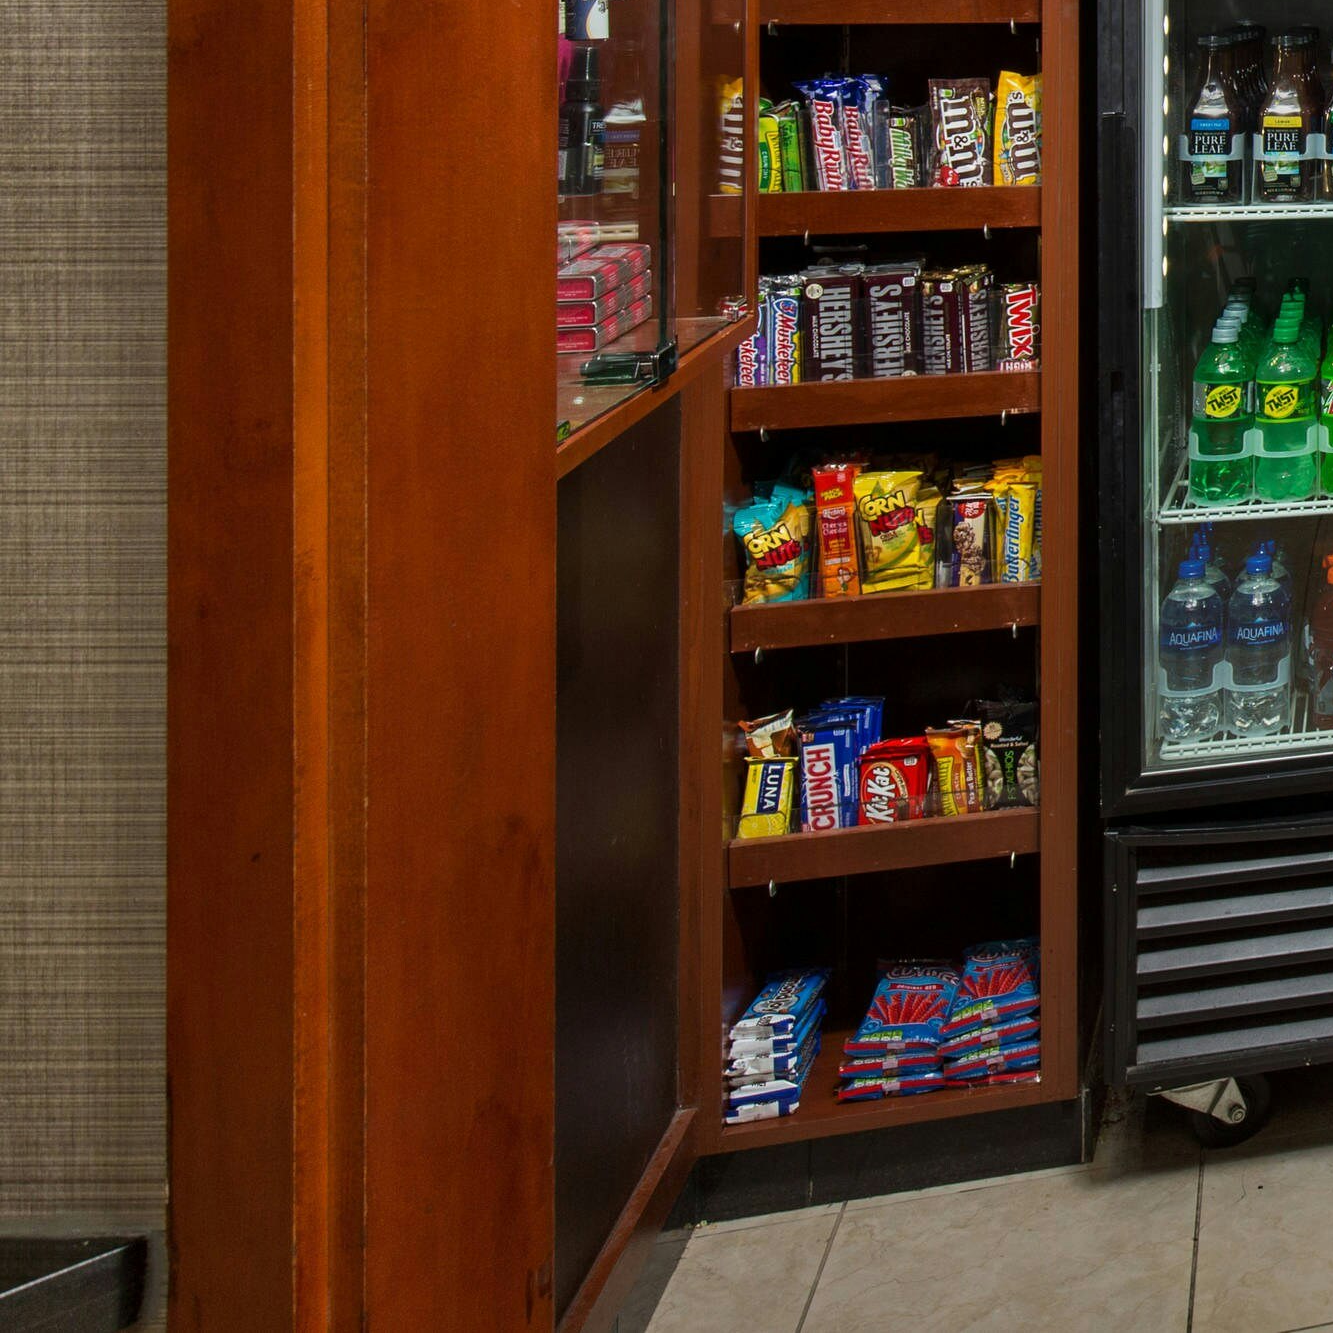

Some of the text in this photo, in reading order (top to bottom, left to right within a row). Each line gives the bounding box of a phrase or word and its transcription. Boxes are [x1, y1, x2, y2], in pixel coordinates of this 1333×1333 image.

[1194, 135, 1227, 145] PURE
[1194, 144, 1225, 154] LEAF
[1267, 132, 1299, 142] PURE
[1267, 141, 1296, 151] LEAF
[889, 128, 915, 188] Milky Wa
[776, 312, 797, 384] Musketeer
[819, 286, 854, 381] HERSHEY'S
[870, 283, 905, 378] HERSHEY'S
[739, 338, 758, 386] sketeer
[859, 490, 906, 523] CORN
[744, 524, 791, 559] CORN
[1002, 495, 1025, 582] Butterfinger
[1169, 627, 1218, 648] AQUAFINA
[1237, 623, 1284, 641] AQUAFINA
[762, 765, 781, 809] LUNA
[807, 747, 836, 831] CRUNCH
[966, 761, 974, 781] Butter
[1004, 750, 1017, 800] PISTACHIOS
